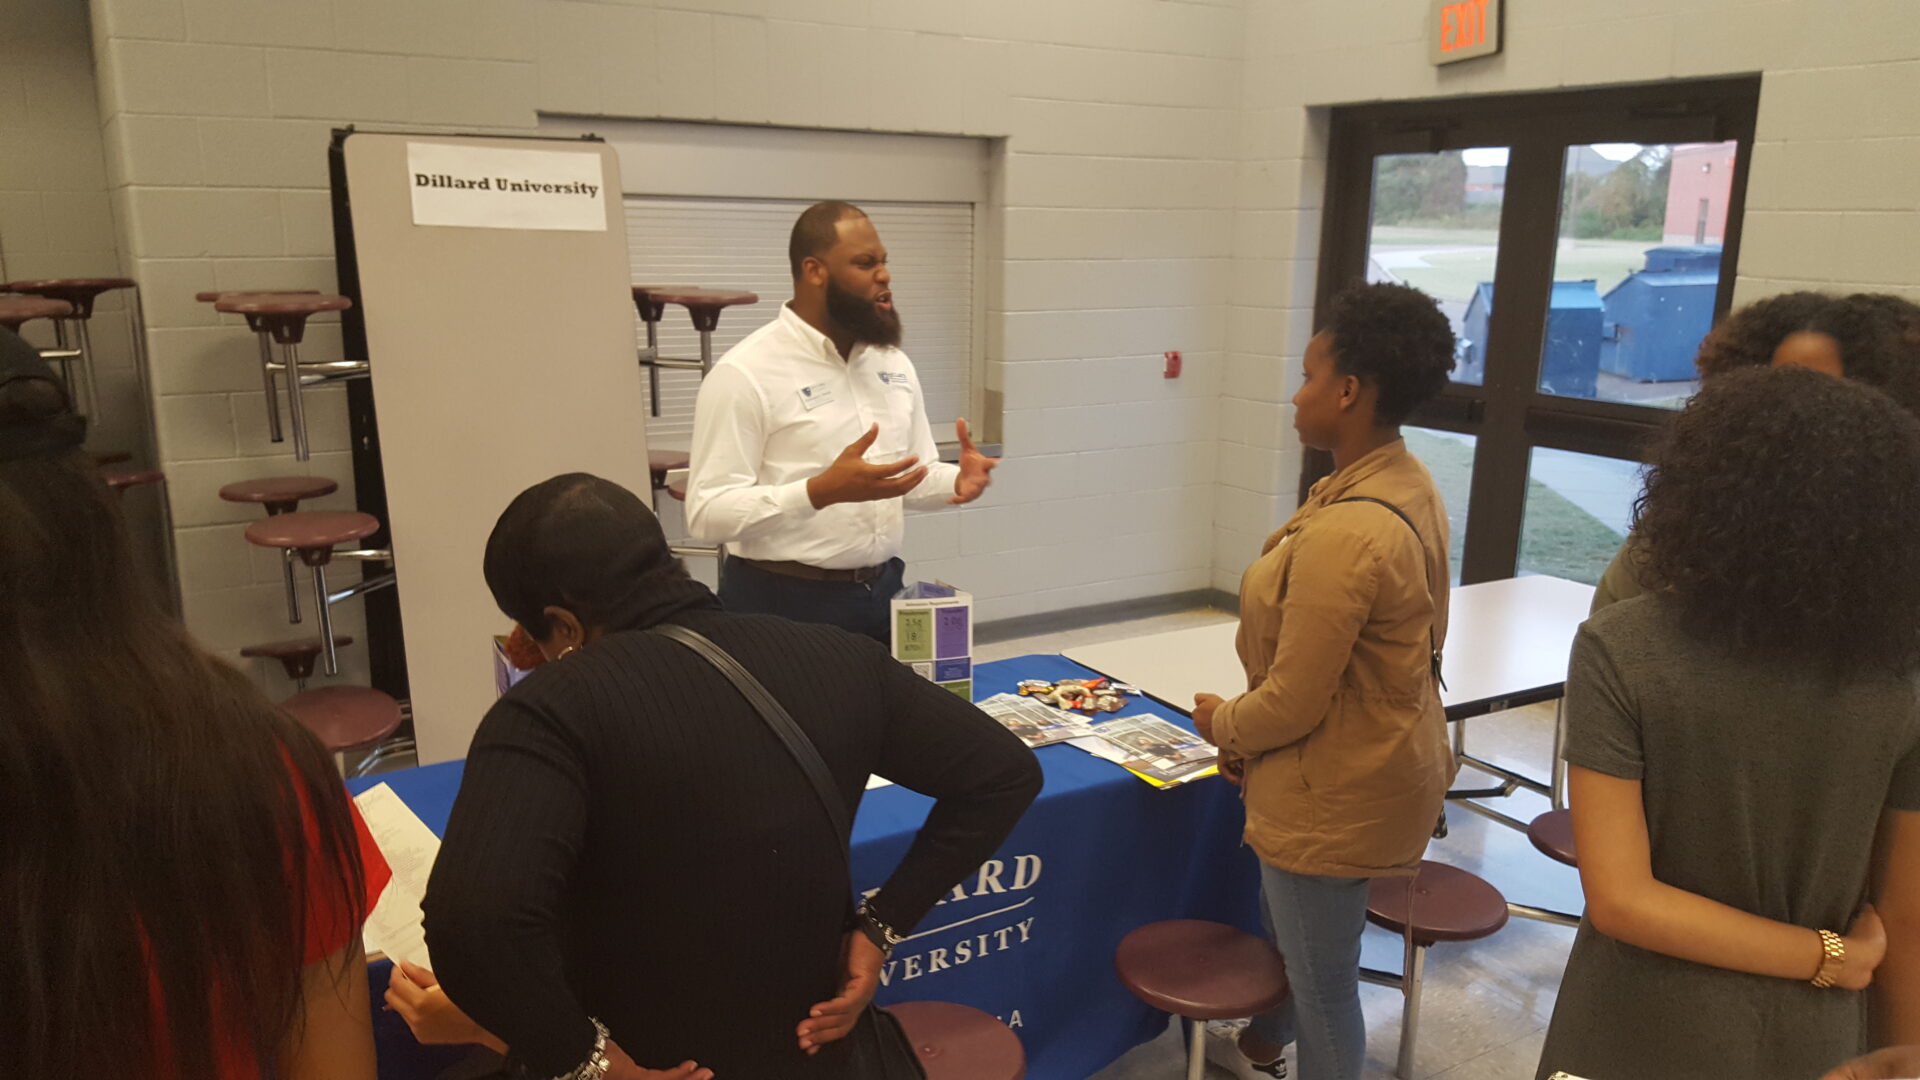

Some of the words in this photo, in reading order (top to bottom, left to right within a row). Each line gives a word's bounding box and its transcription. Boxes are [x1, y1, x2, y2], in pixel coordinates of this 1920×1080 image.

[1440, 0, 1488, 52] EXIT
[415, 173, 491, 191] Dillard
[495, 178, 599, 199] University
